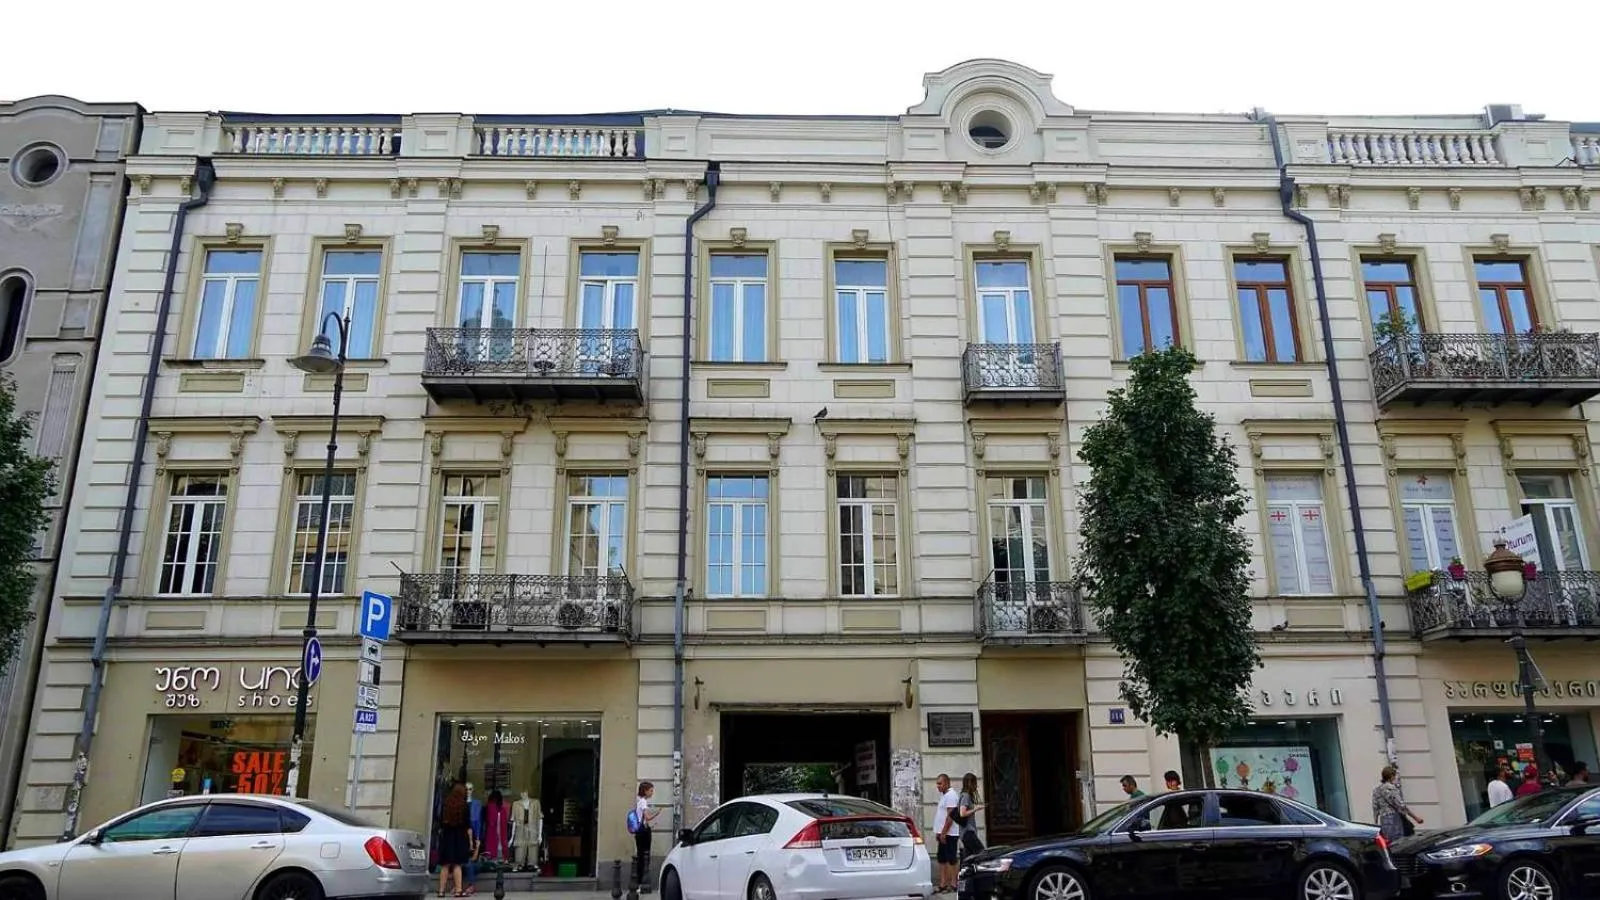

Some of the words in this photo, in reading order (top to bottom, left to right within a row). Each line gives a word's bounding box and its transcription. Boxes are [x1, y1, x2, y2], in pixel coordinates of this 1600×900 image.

[366, 596, 385, 632] P
[238, 691, 313, 707] shoes
[232, 751, 285, 774] SALE
